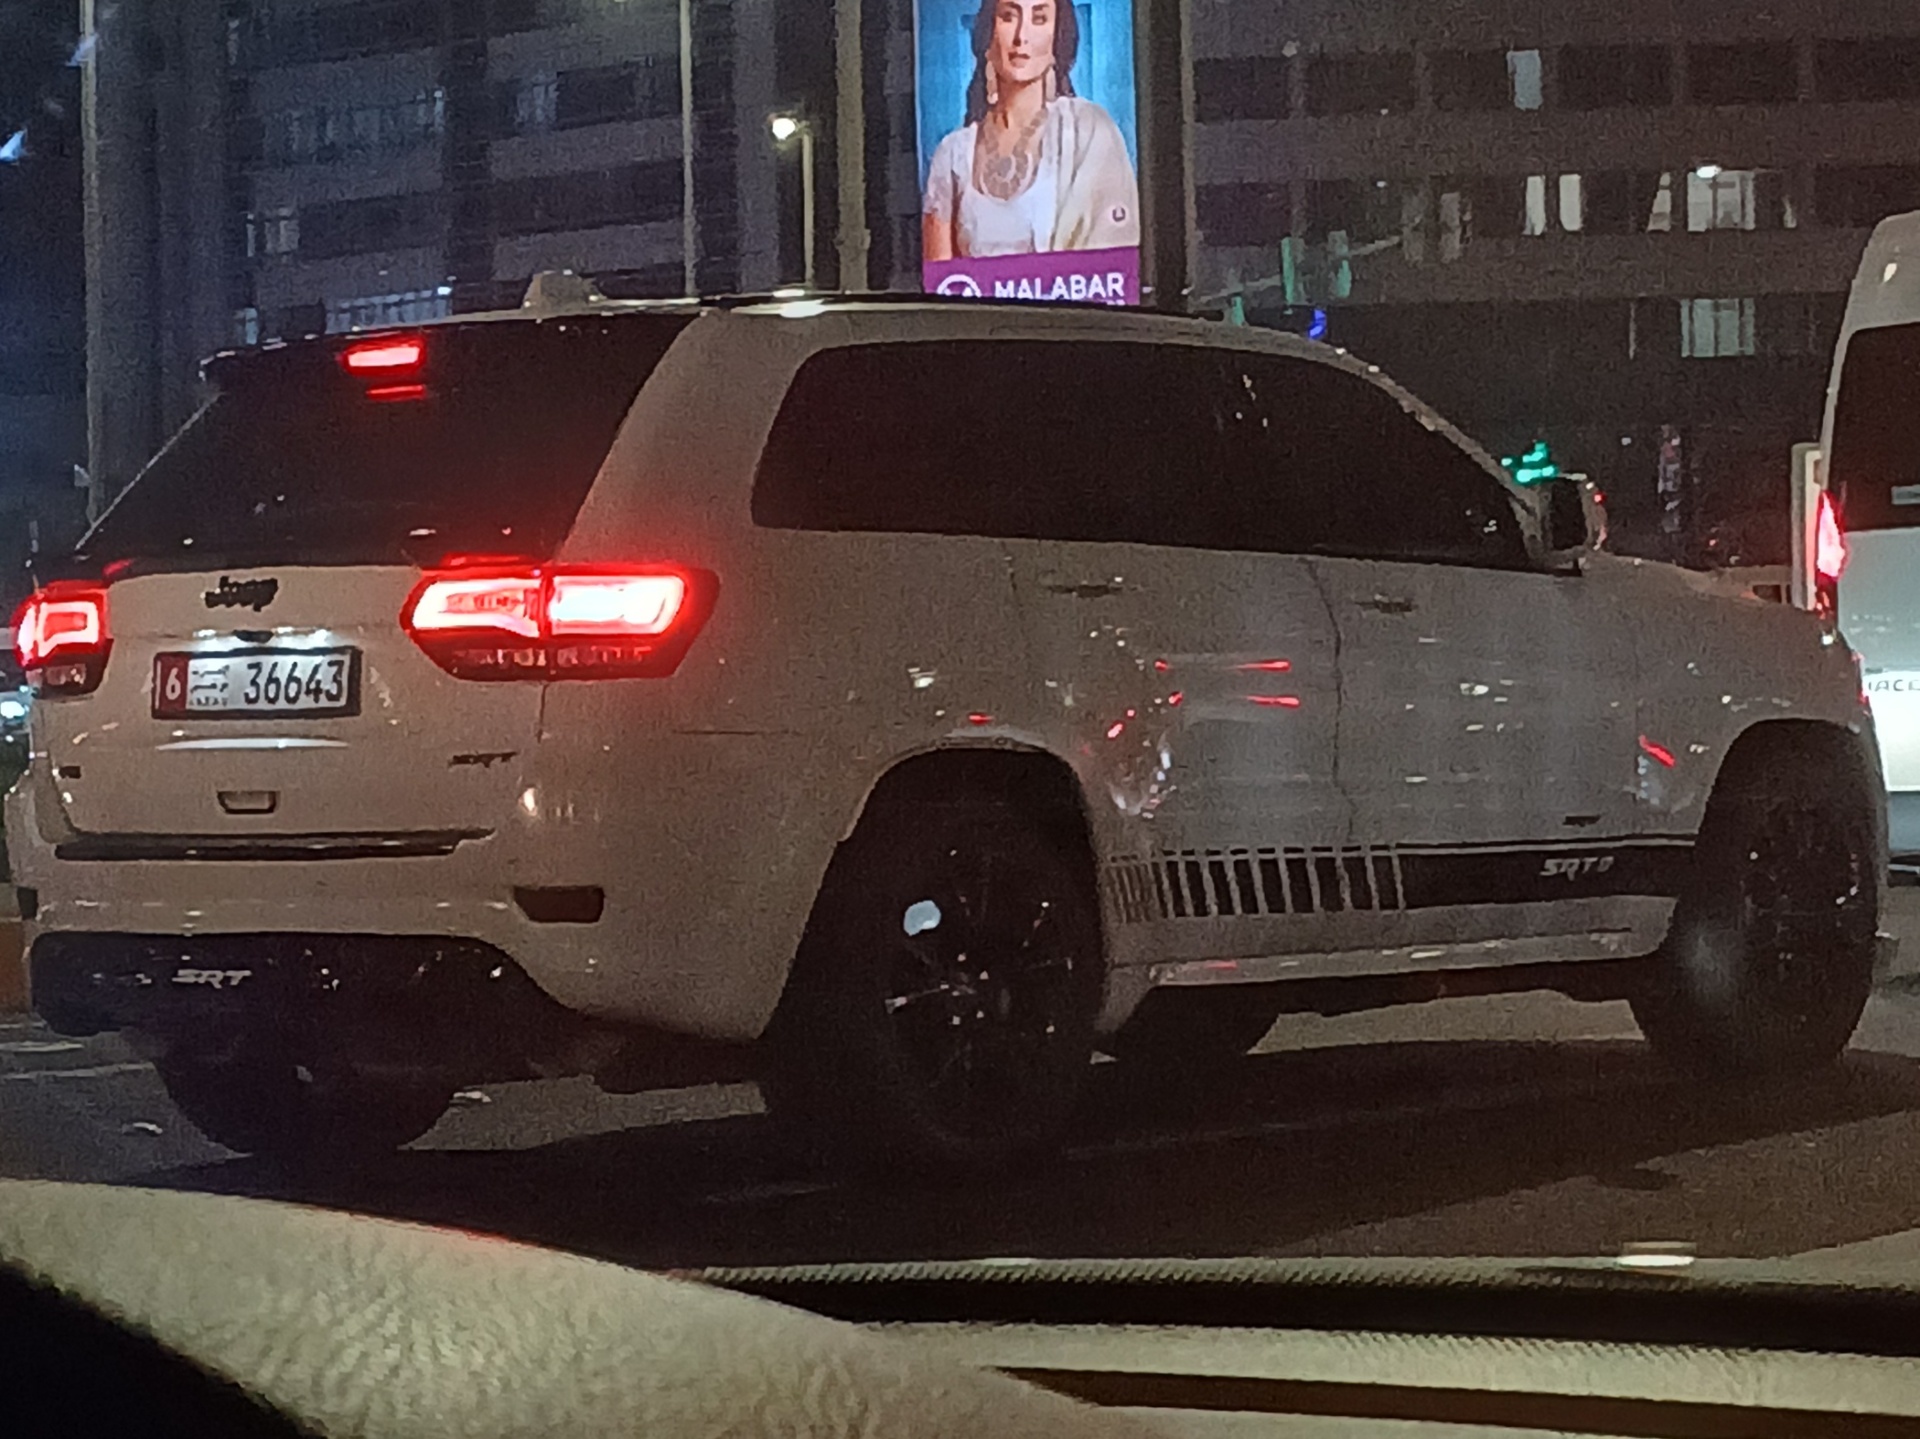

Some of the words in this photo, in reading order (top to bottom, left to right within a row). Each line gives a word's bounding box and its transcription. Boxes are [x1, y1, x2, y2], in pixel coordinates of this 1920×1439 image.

[994, 271, 1125, 301] MALABAR
[165, 667, 181, 700] 6
[244, 659, 345, 704] 36643
[171, 968, 252, 989] SRT
